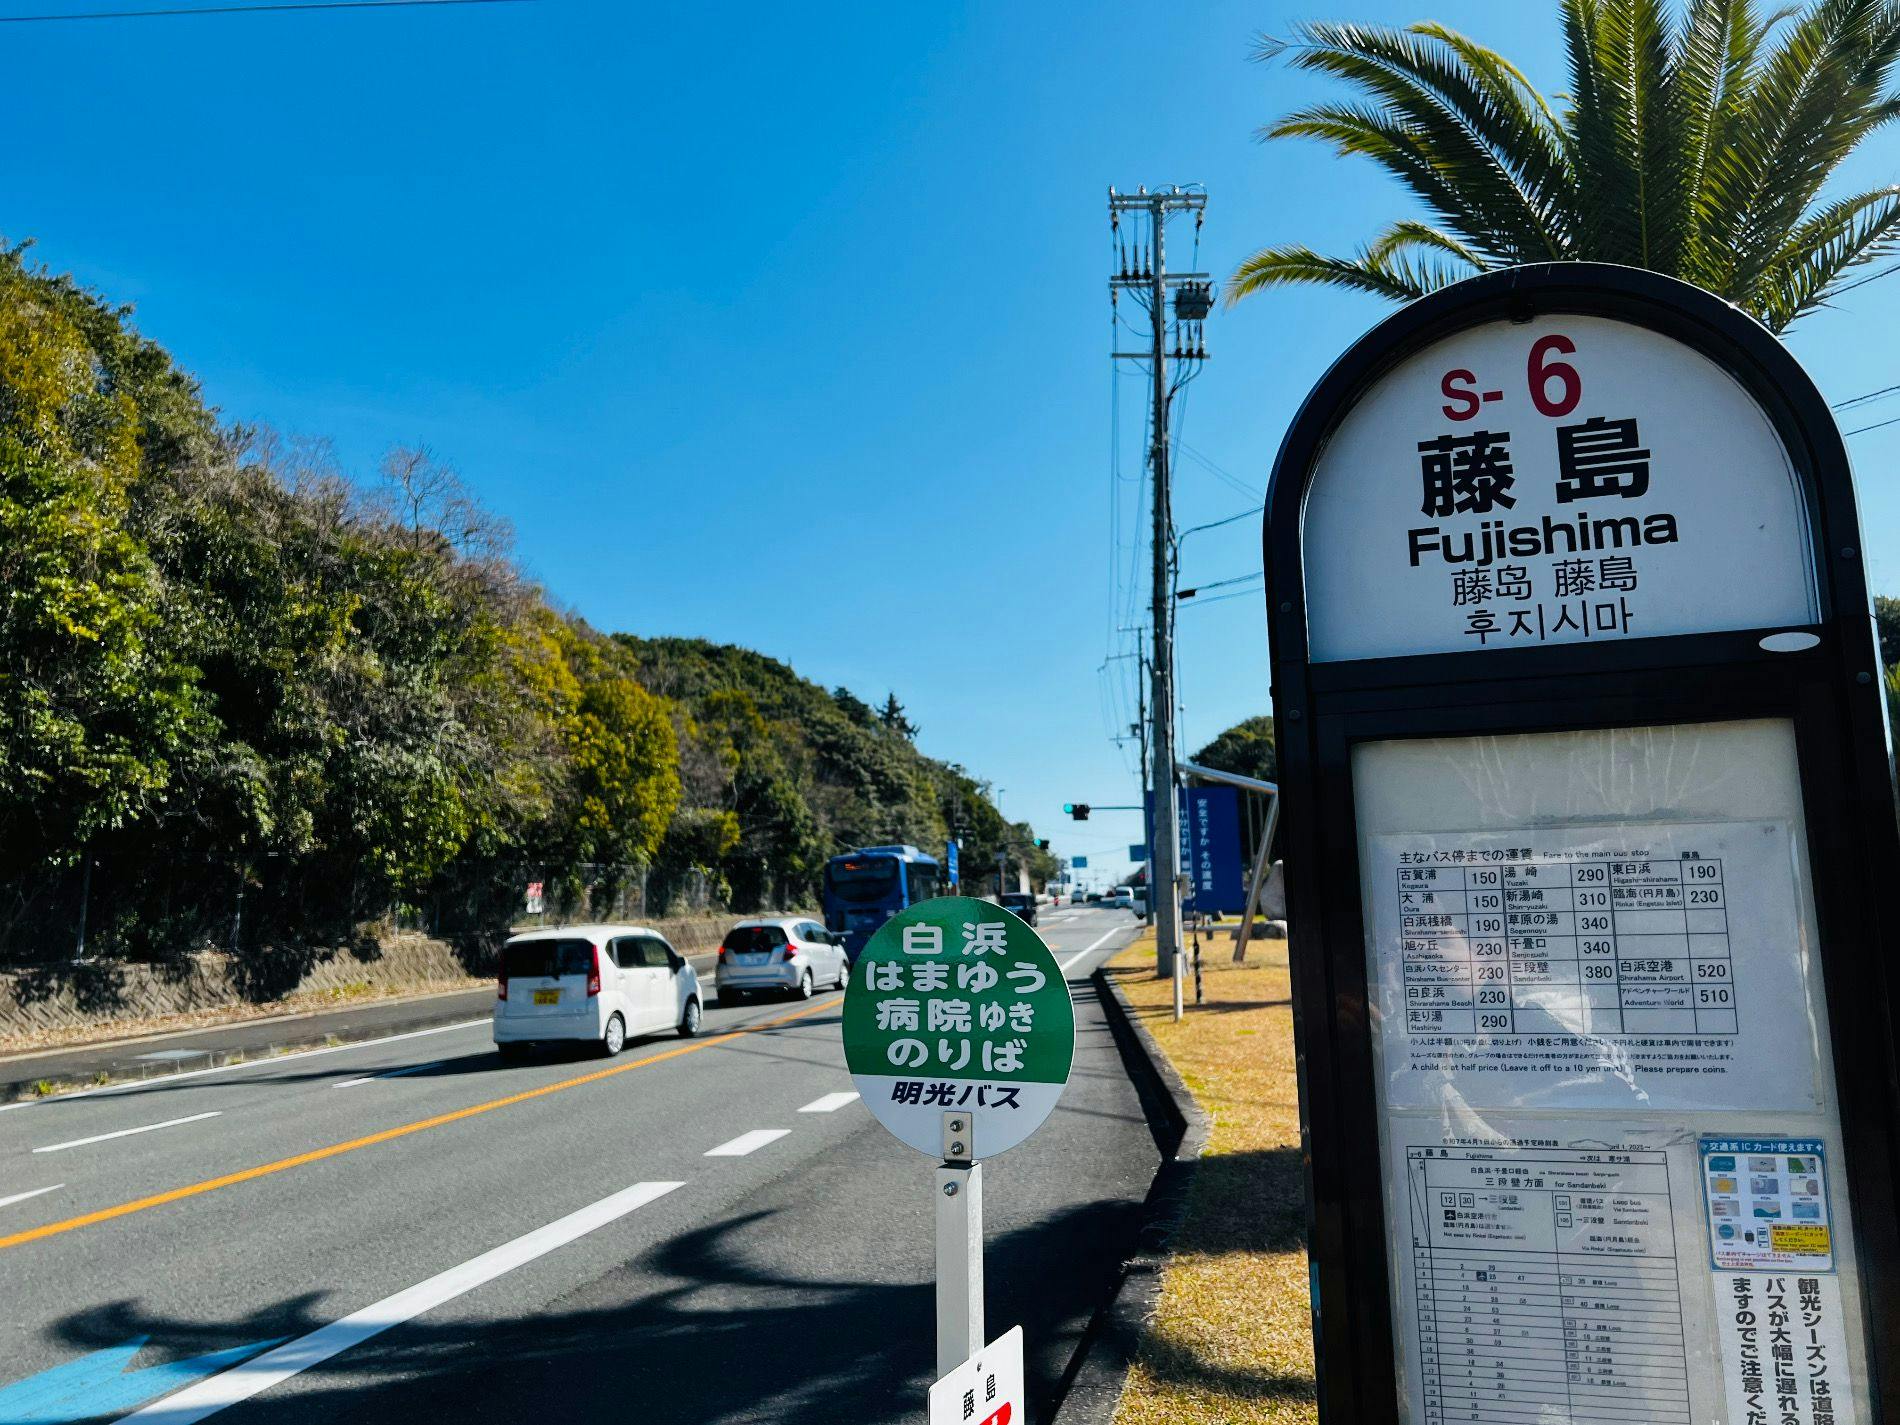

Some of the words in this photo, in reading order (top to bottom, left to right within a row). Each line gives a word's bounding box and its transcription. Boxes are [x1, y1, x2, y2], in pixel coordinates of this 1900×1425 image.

[1418, 417, 1650, 518] 藤島
[1408, 512, 1679, 567] Fujishima
[1451, 565, 1532, 606] 藤岛
[1552, 556, 1638, 597] 藤島
[1464, 597, 1633, 645] 후지시마
[1592, 850, 1611, 858] main
[1577, 869, 1604, 882] 290
[1612, 863, 1651, 875] 東白浜
[1689, 865, 1716, 879] 190
[1471, 871, 1497, 884] 150
[1474, 895, 1499, 908] 150
[1579, 893, 1606, 905] 310
[1690, 890, 1719, 903] 230
[1476, 919, 1500, 932] 190
[1508, 913, 1559, 926] 草原の湯
[1581, 917, 1608, 930] 340
[903, 922, 1008, 956] 白浜
[1476, 943, 1502, 955] 230
[1583, 941, 1610, 954] 340
[1585, 965, 1612, 979] 380
[1620, 959, 1673, 972] 白浜空港
[1697, 964, 1726, 978] 520
[865, 960, 1046, 994] はまゆう
[1478, 967, 1504, 980] 230
[1480, 991, 1506, 1004] 230
[1700, 989, 1729, 1003] 510
[875, 997, 1034, 1033] 病院ゆき
[1481, 1015, 1508, 1028] 290
[887, 1038, 1028, 1073] のりば
[1478, 1064, 1499, 1073] price
[1500, 1064, 1529, 1073] (Leave
[1530, 1064, 1538, 1072] it
[1540, 1063, 1552, 1072] off
[1553, 1064, 1562, 1072] to
[1573, 1064, 1583, 1072] 10
[1586, 1066, 1601, 1074] yen
[1634, 1064, 1664, 1073] Please
[1666, 1066, 1700, 1075] prepare
[1702, 1065, 1728, 1074] coins.
[891, 1081, 1021, 1110] 明光バス
[1485, 1177, 1544, 1188] 三段壁方面
[1732, 1277, 1767, 1425] ますのでご注意くだ
[1766, 1277, 1800, 1425] バスが大幅に遅れる
[1797, 1278, 1835, 1425] 観光シーズンは道路
[963, 1373, 997, 1421] 藤島
